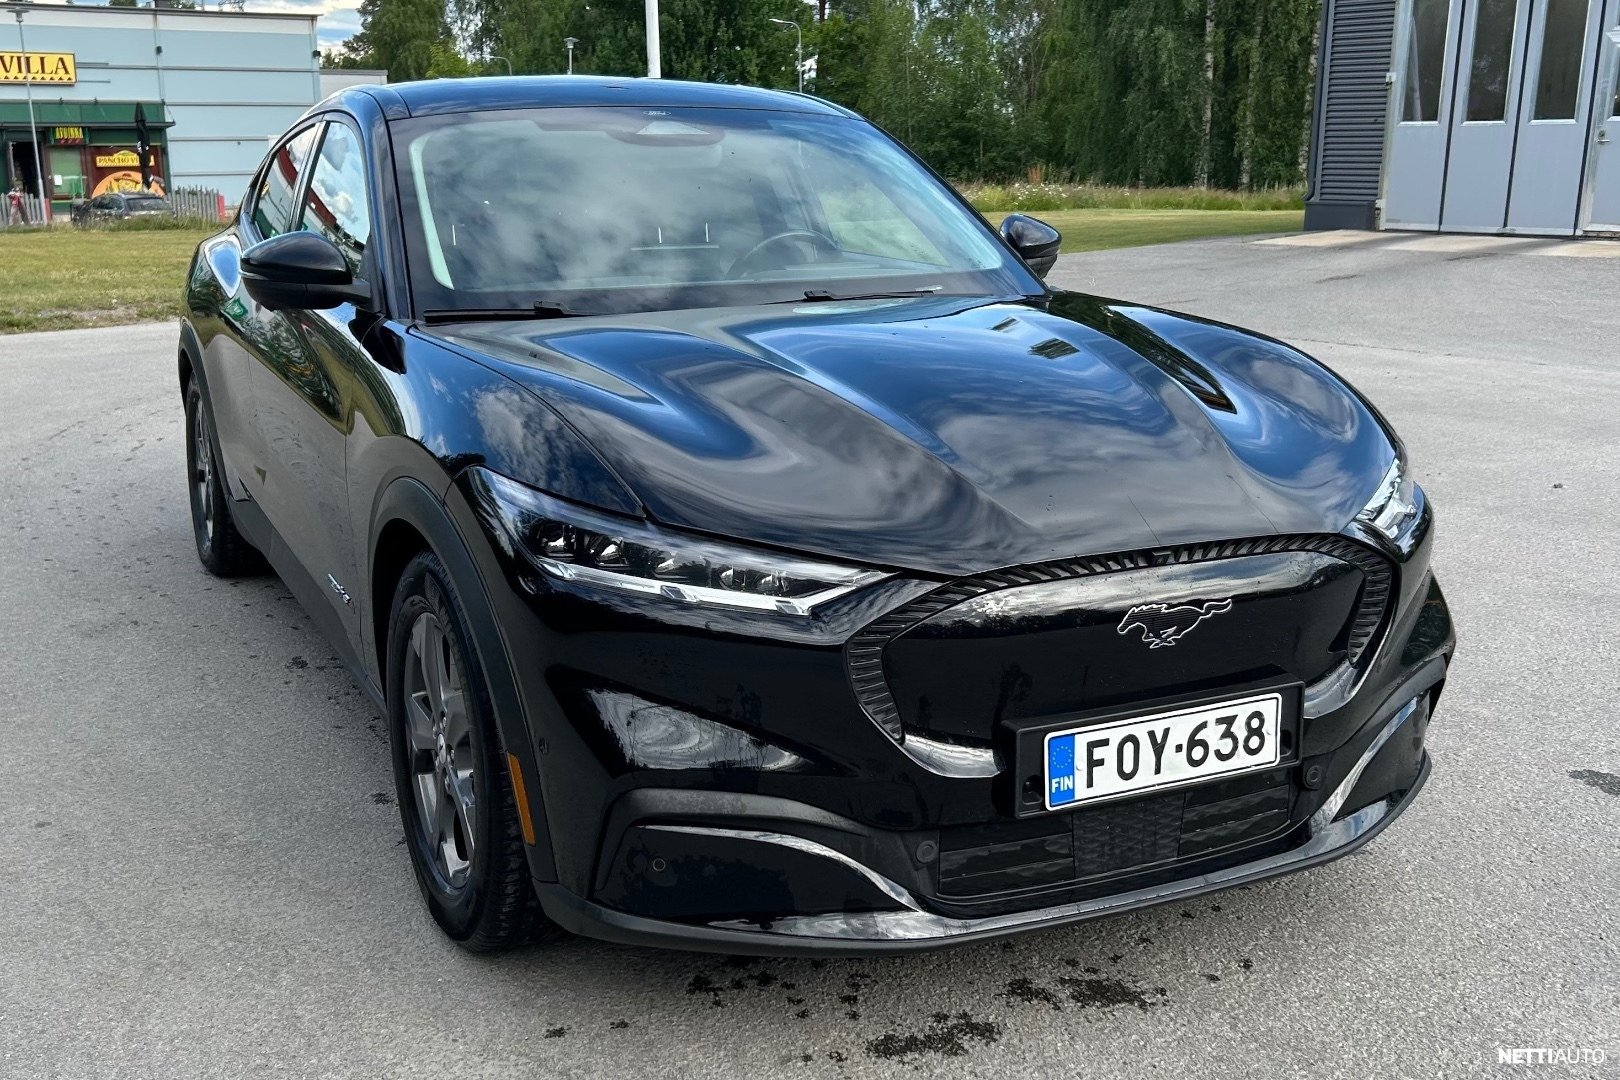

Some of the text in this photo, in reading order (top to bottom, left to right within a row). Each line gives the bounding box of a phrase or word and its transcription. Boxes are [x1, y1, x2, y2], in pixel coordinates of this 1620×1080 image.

[0, 55, 70, 75] VILLA
[1085, 710, 1266, 788] FOY-638
[1051, 774, 1074, 794] FIN
